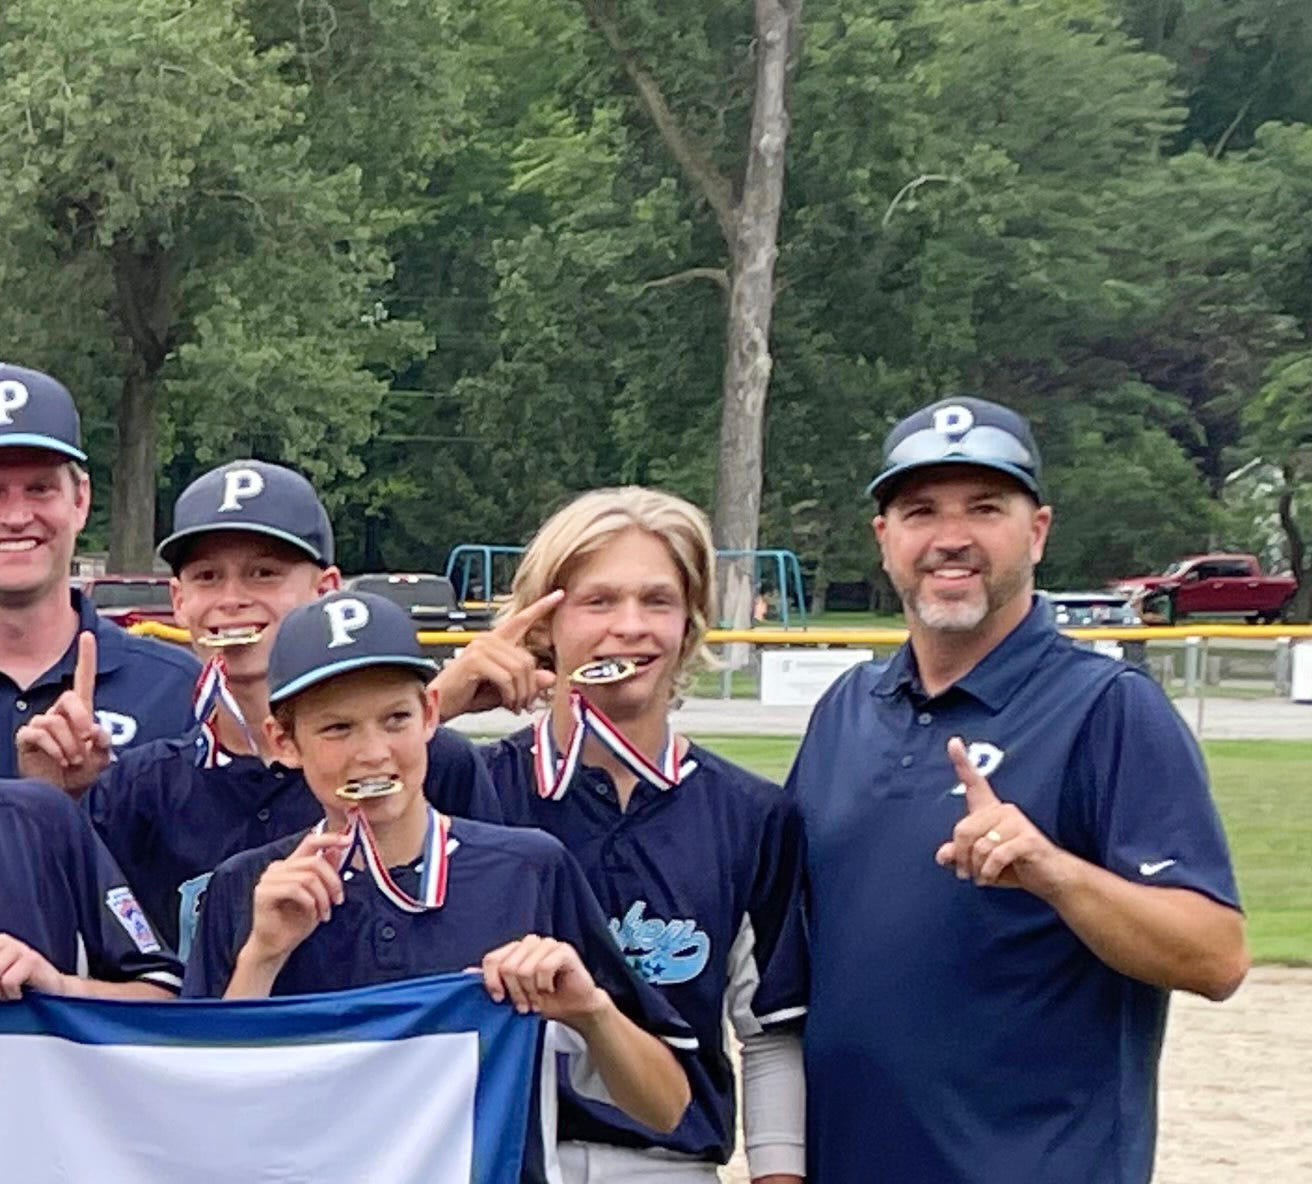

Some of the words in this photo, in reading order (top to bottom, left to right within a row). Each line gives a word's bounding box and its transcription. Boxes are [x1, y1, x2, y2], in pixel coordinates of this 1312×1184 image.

[933, 404, 974, 434] P
[217, 468, 264, 512] P
[323, 598, 369, 648] P
